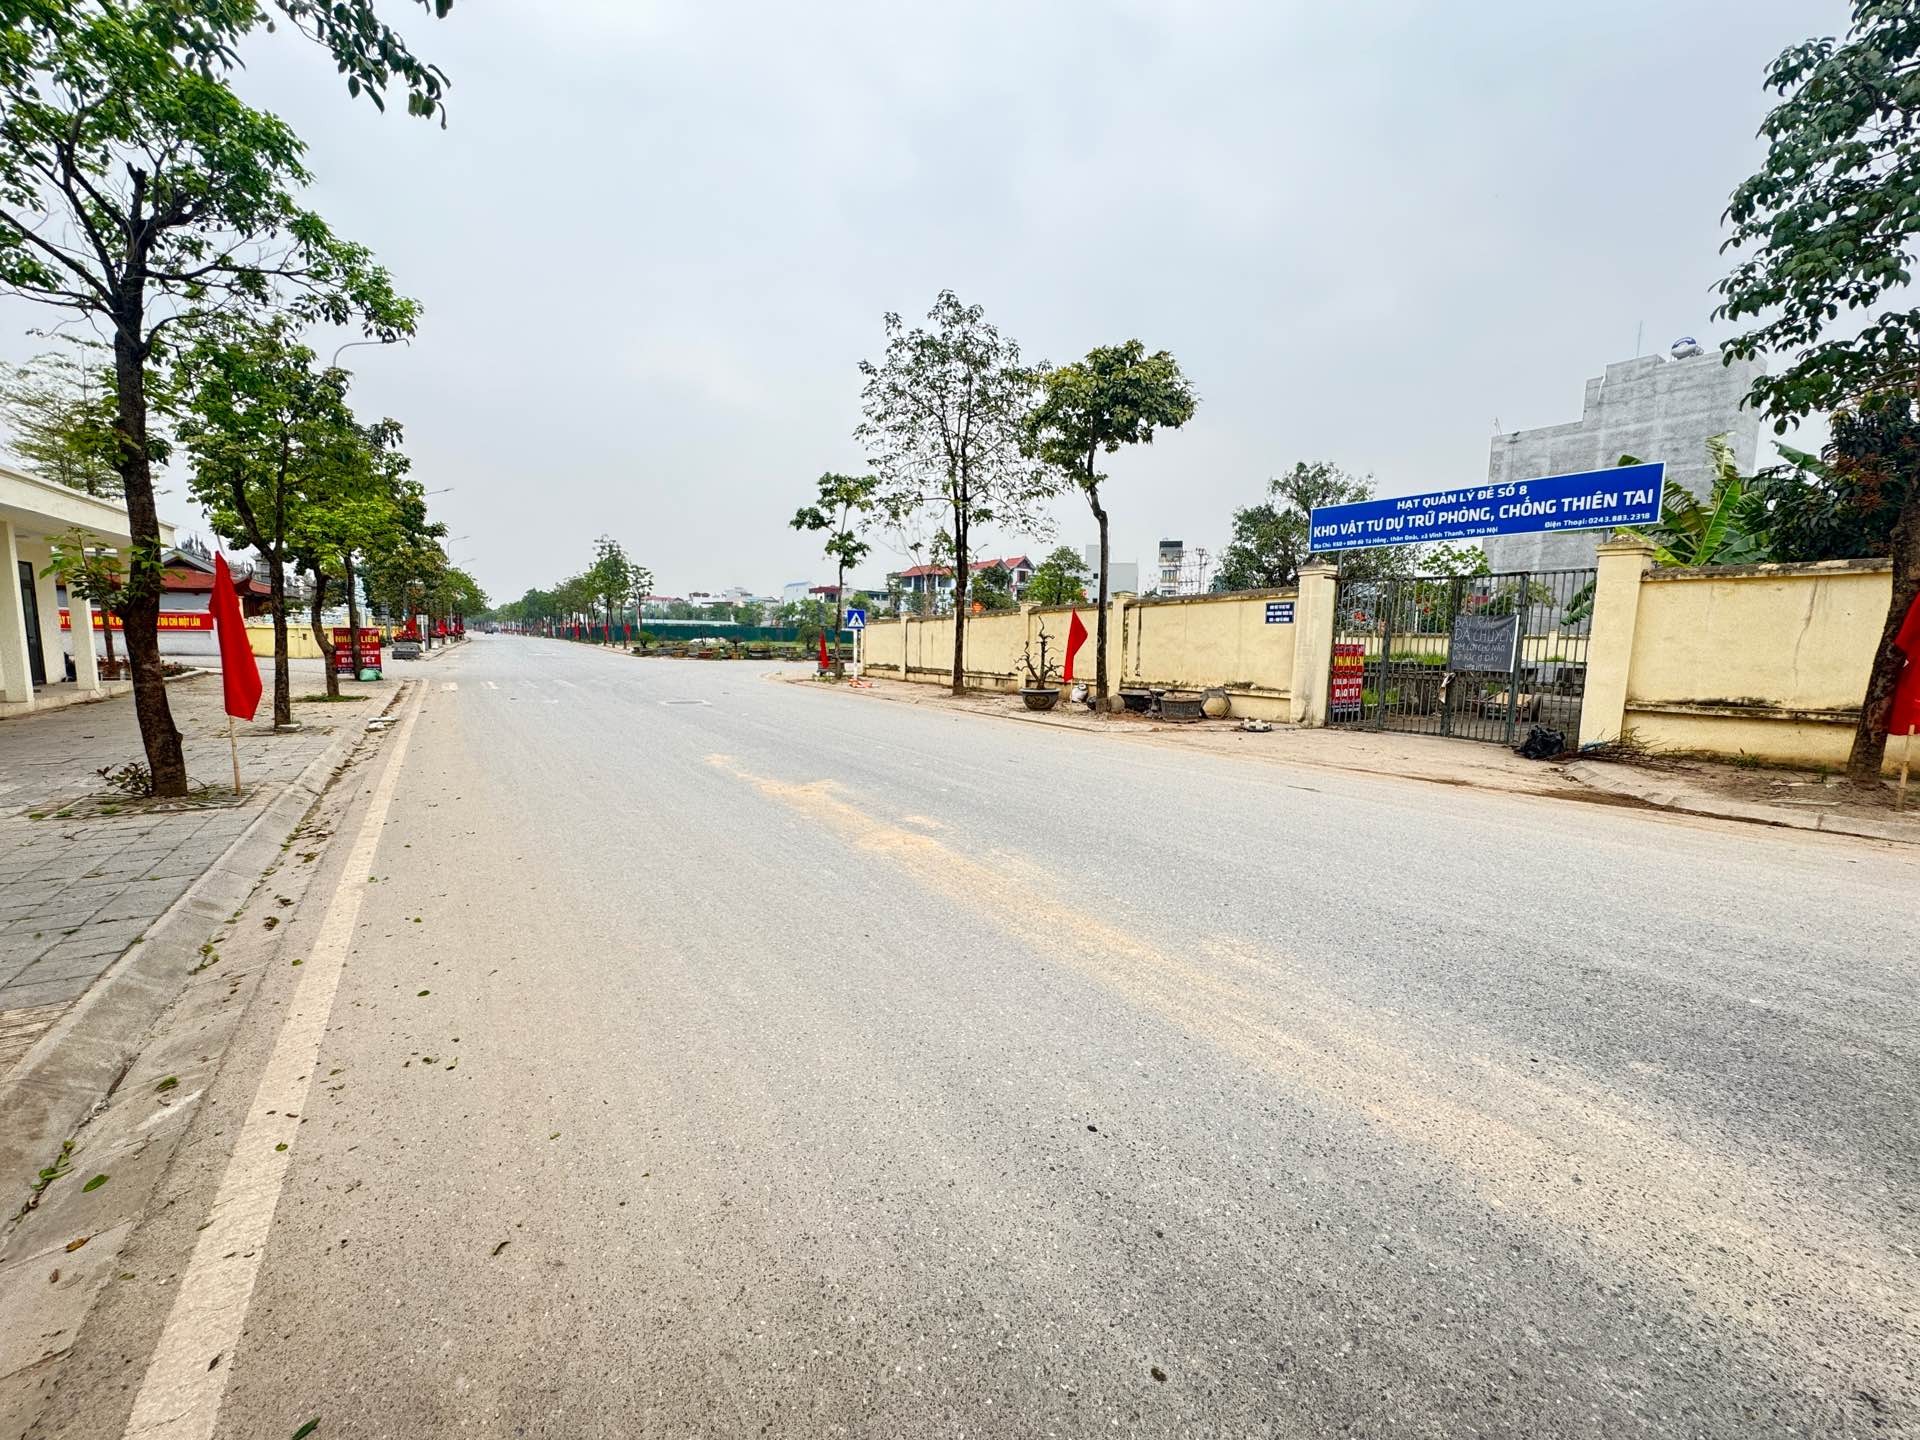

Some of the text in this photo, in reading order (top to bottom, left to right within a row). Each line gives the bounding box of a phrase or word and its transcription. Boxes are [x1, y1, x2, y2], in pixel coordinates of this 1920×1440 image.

[1313, 488, 1654, 538] KHO VẬT TƯ DỰ TRỮ PHÒNG, CHỐNG THIÊN TAI
[1396, 481, 1528, 511] HẠT QUẢN LÝ ĐÊ SỐ 8
